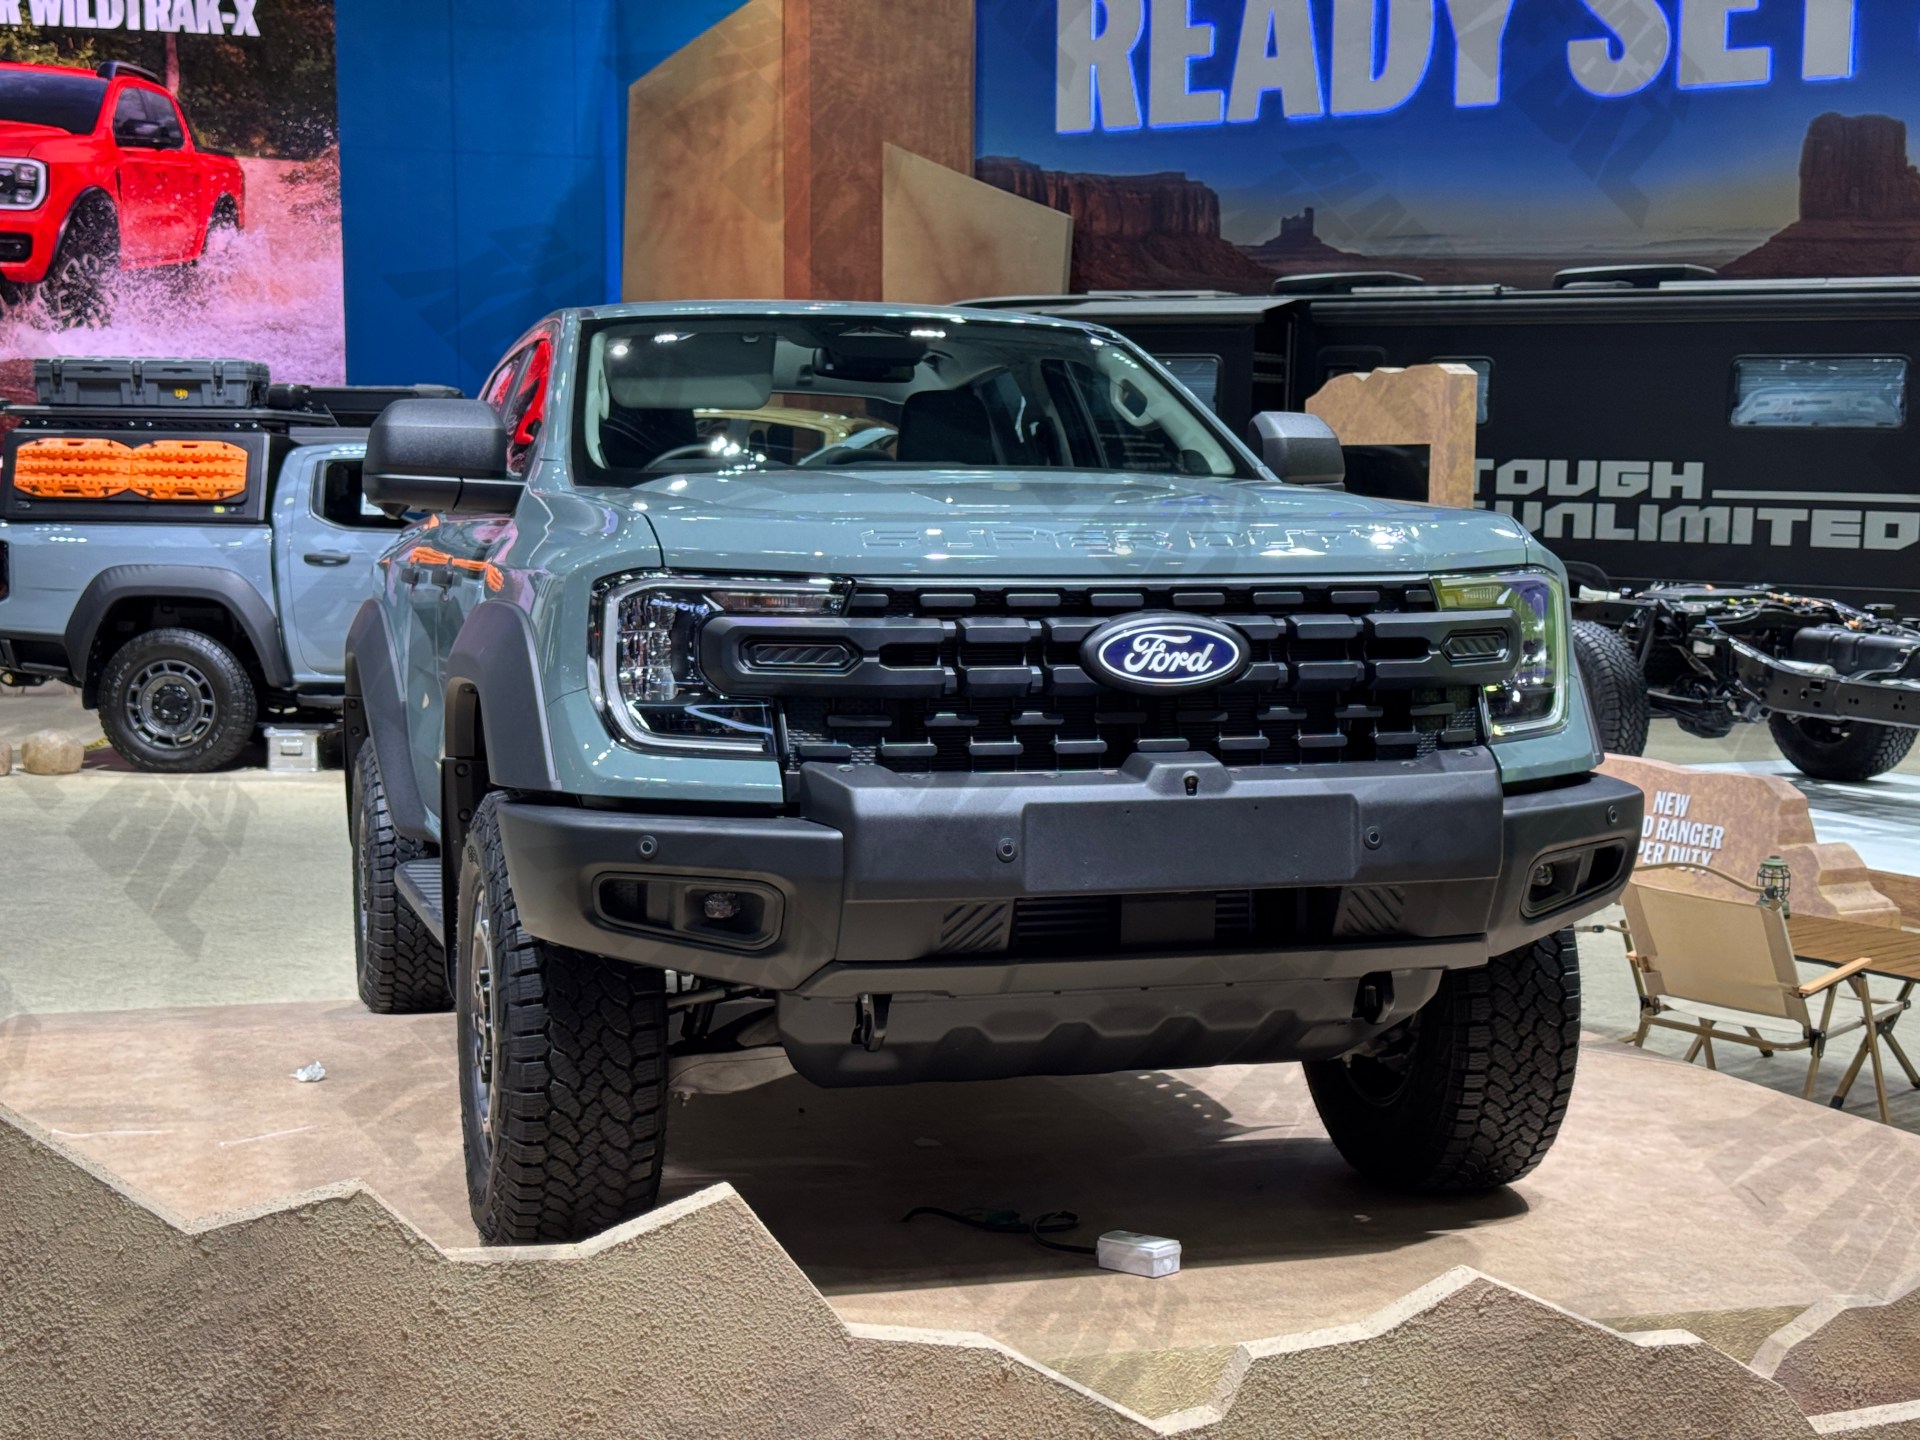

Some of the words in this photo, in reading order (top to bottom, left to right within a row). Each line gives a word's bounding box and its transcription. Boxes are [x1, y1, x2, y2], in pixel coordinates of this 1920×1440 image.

[1056, 0, 1514, 134] READY
[1495, 501, 1920, 551] UNLIMITED
[1124, 634, 1215, 673] Ford
[1653, 791, 1691, 817] NEW
[1656, 817, 1725, 850] RANGER
[1667, 845, 1714, 875] DUTY
